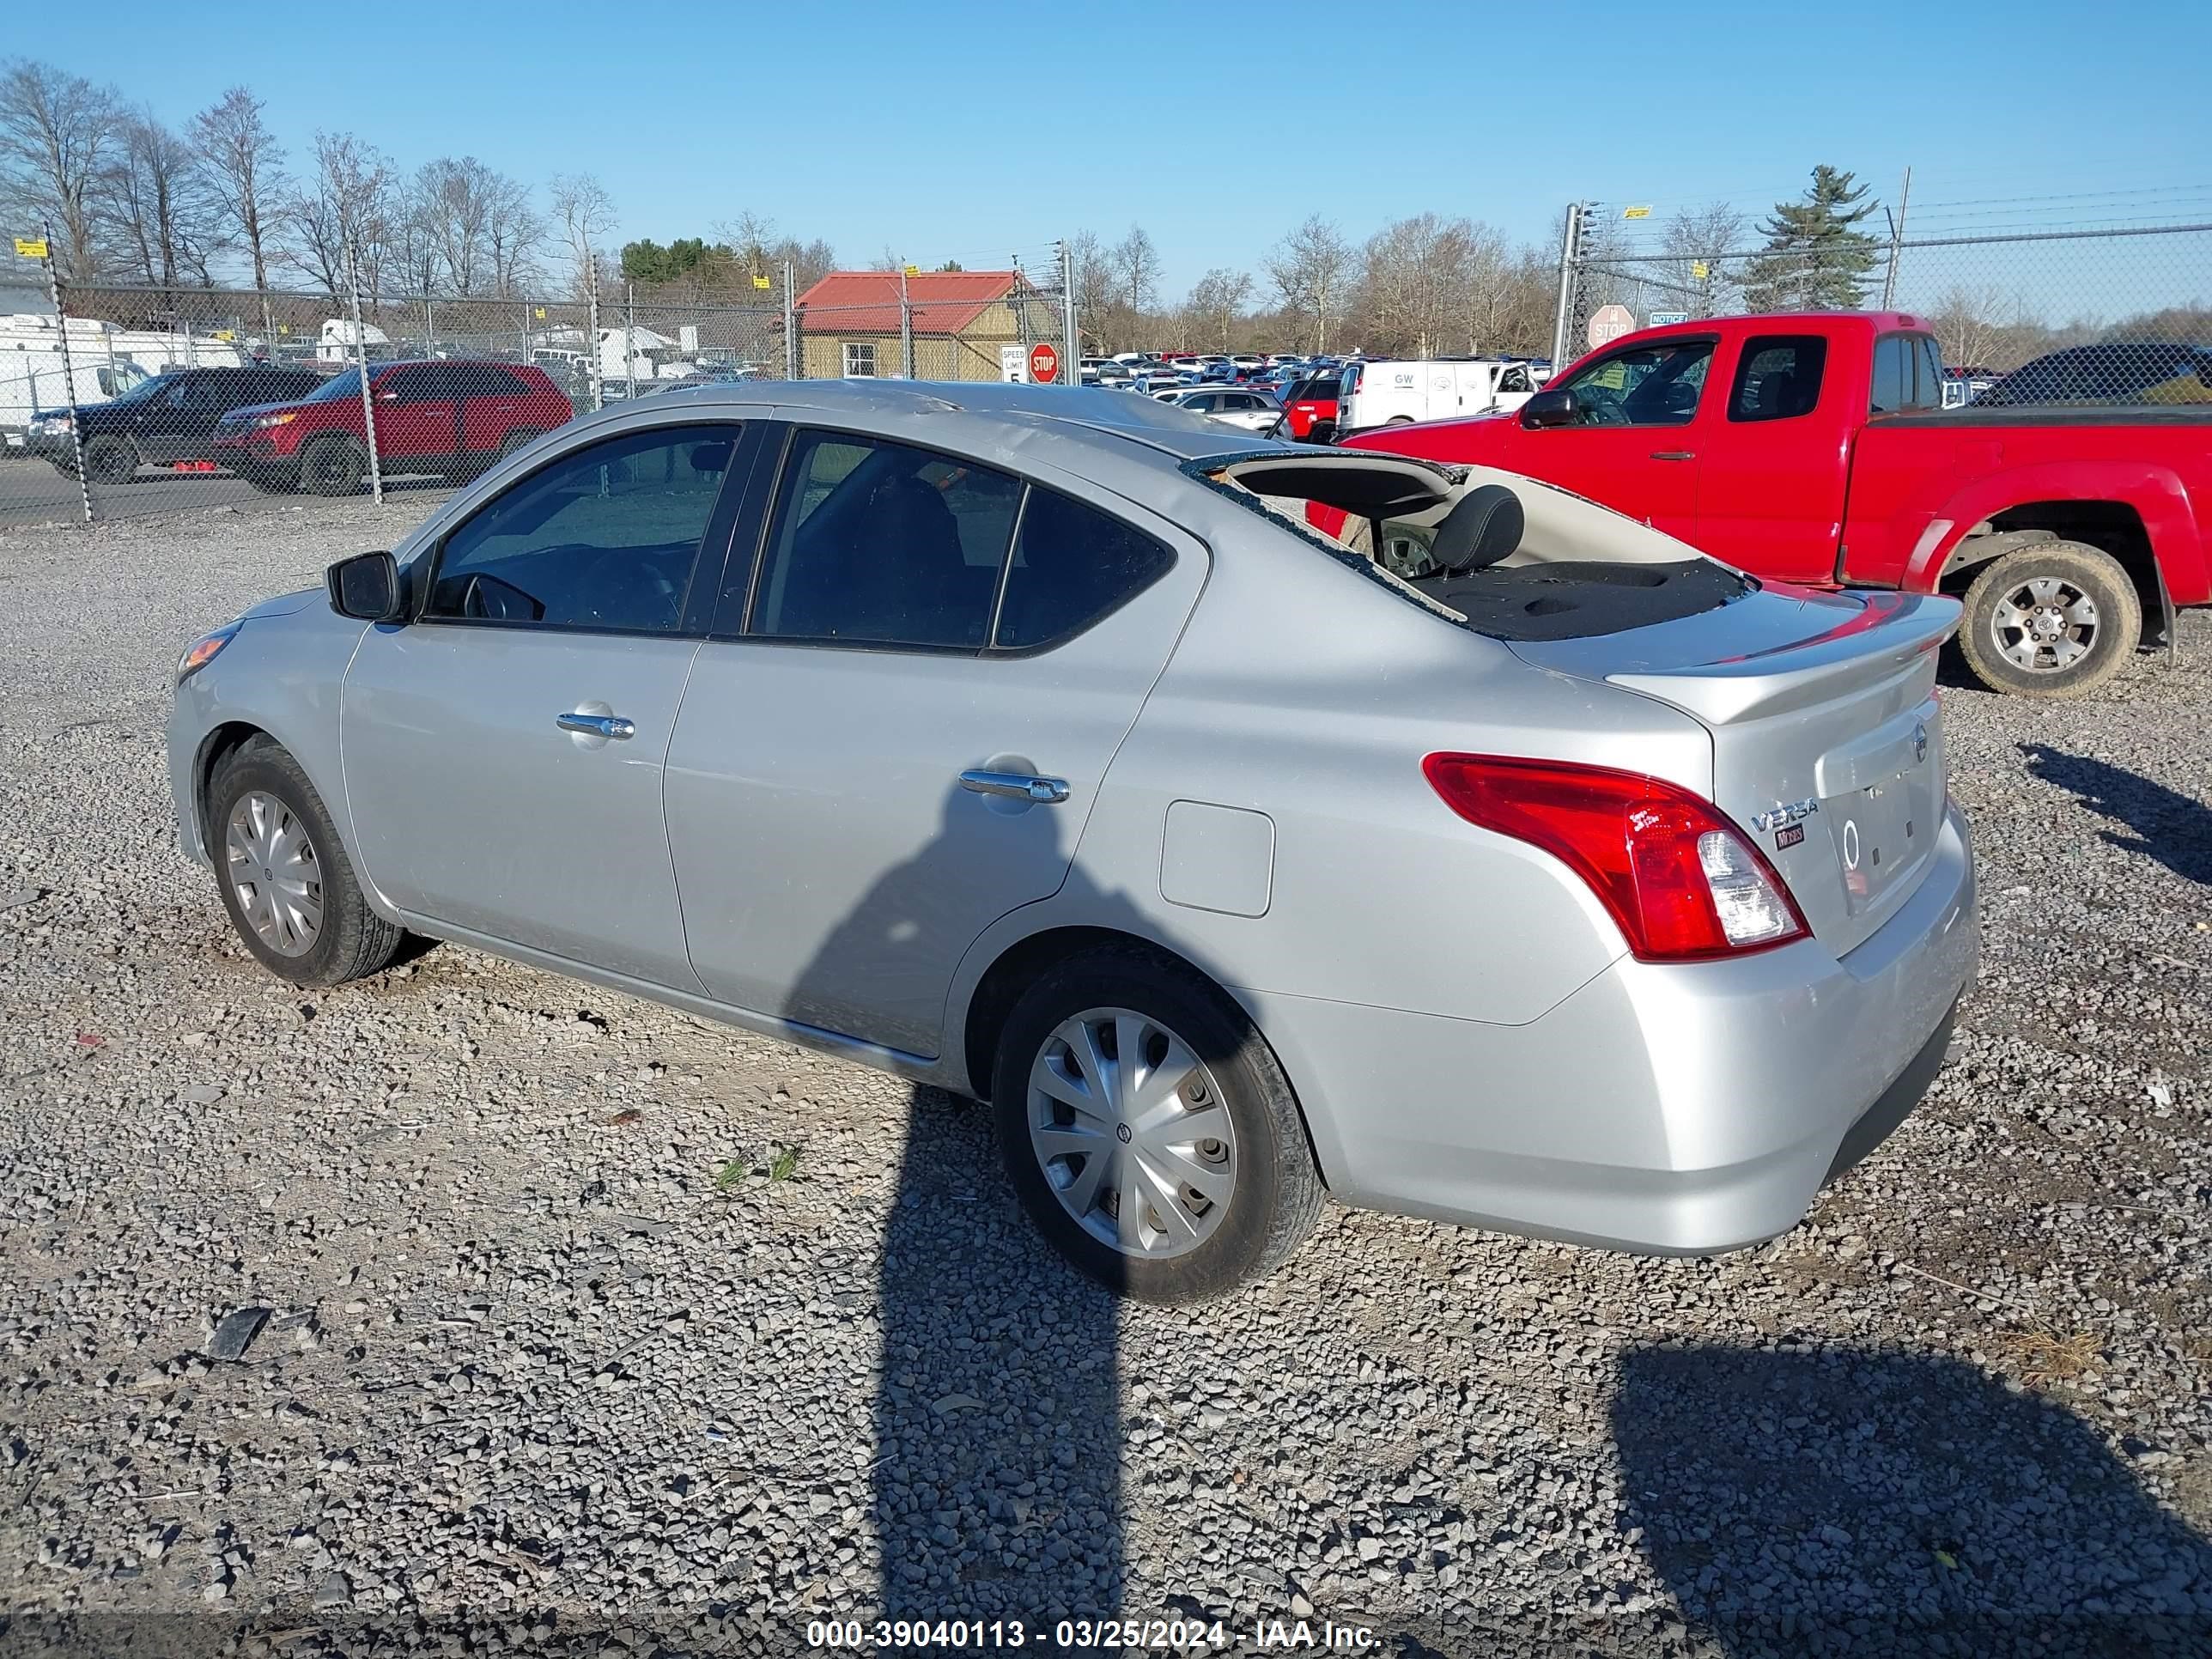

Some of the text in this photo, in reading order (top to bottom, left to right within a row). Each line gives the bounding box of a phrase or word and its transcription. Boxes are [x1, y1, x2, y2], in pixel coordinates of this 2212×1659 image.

[1652, 315, 1684, 324] NOTICE
[1595, 323, 1627, 337] STOP
[1003, 350, 1024, 359] SPEED
[1033, 356, 1054, 372] STOP
[1395, 374, 1414, 384] GW
[1751, 797, 1819, 833] VERSA
